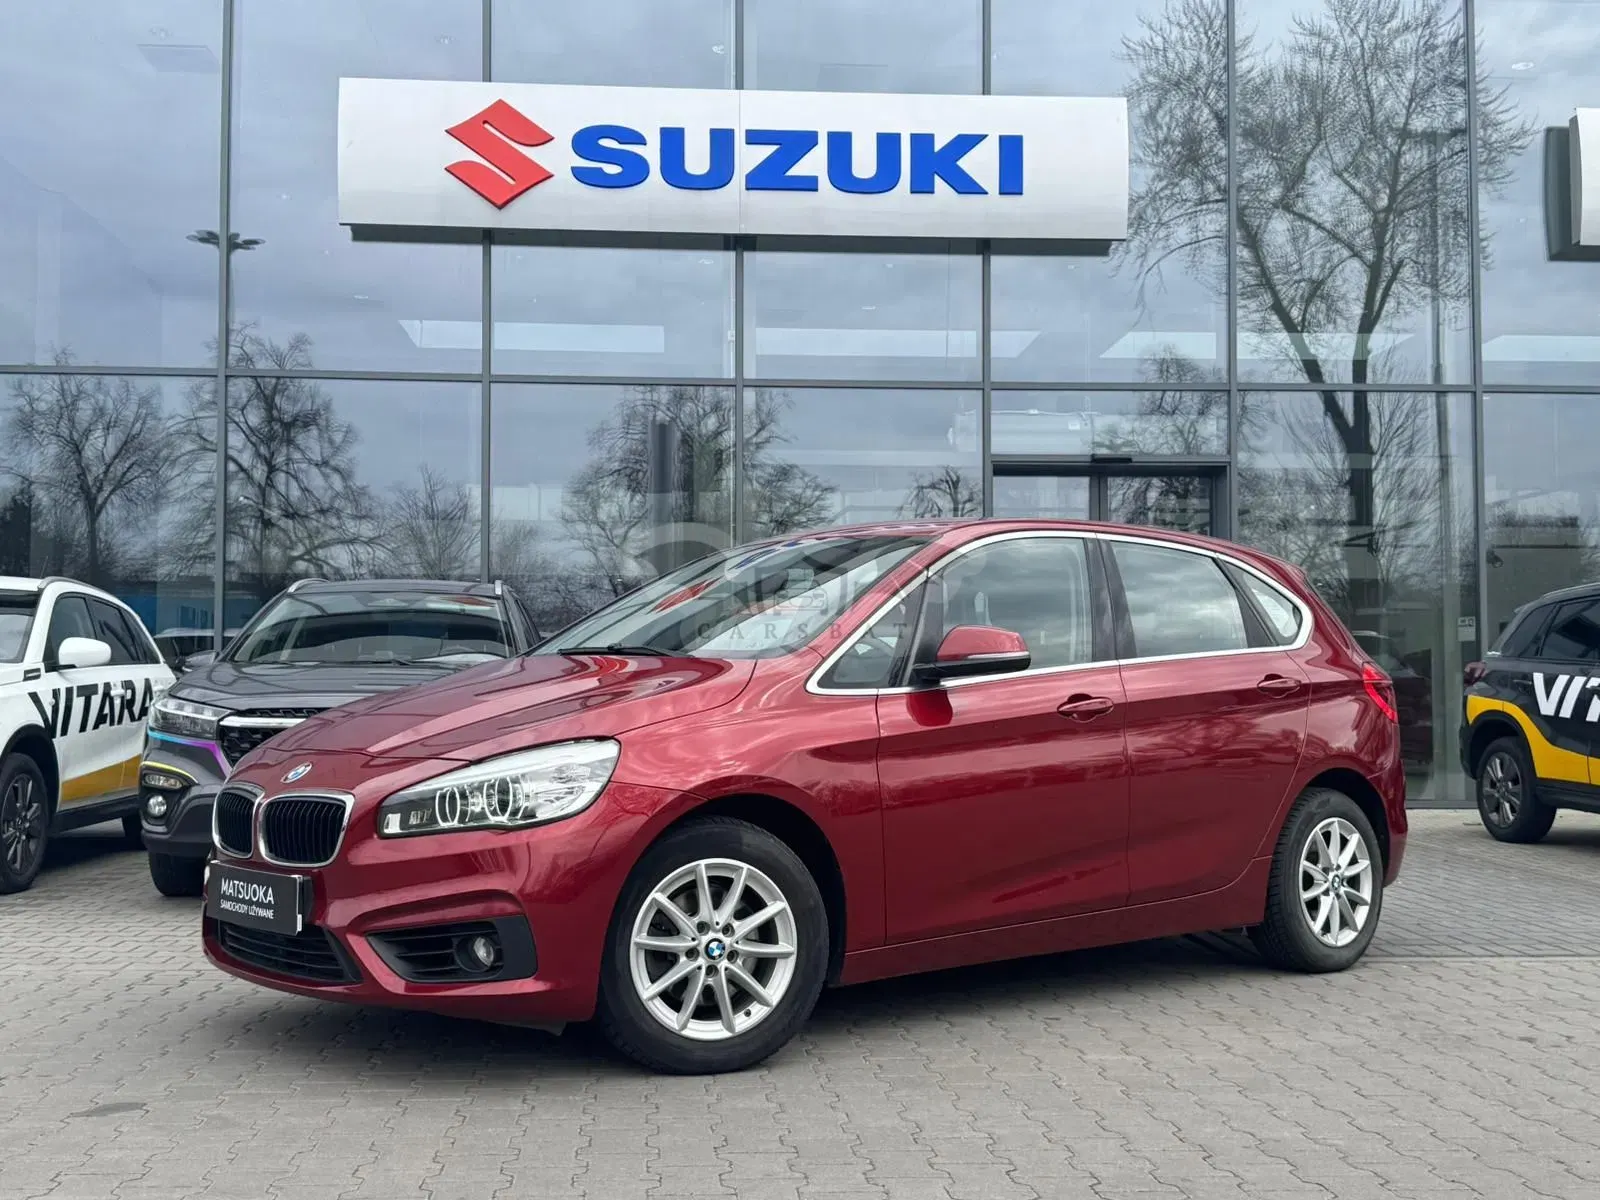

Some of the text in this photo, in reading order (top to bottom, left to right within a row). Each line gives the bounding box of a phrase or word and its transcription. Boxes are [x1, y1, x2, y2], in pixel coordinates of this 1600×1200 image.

[571, 124, 1023, 196] SUZUKI
[220, 877, 274, 904] MATSUOKA
[220, 898, 248, 914] SAMOCHODY
